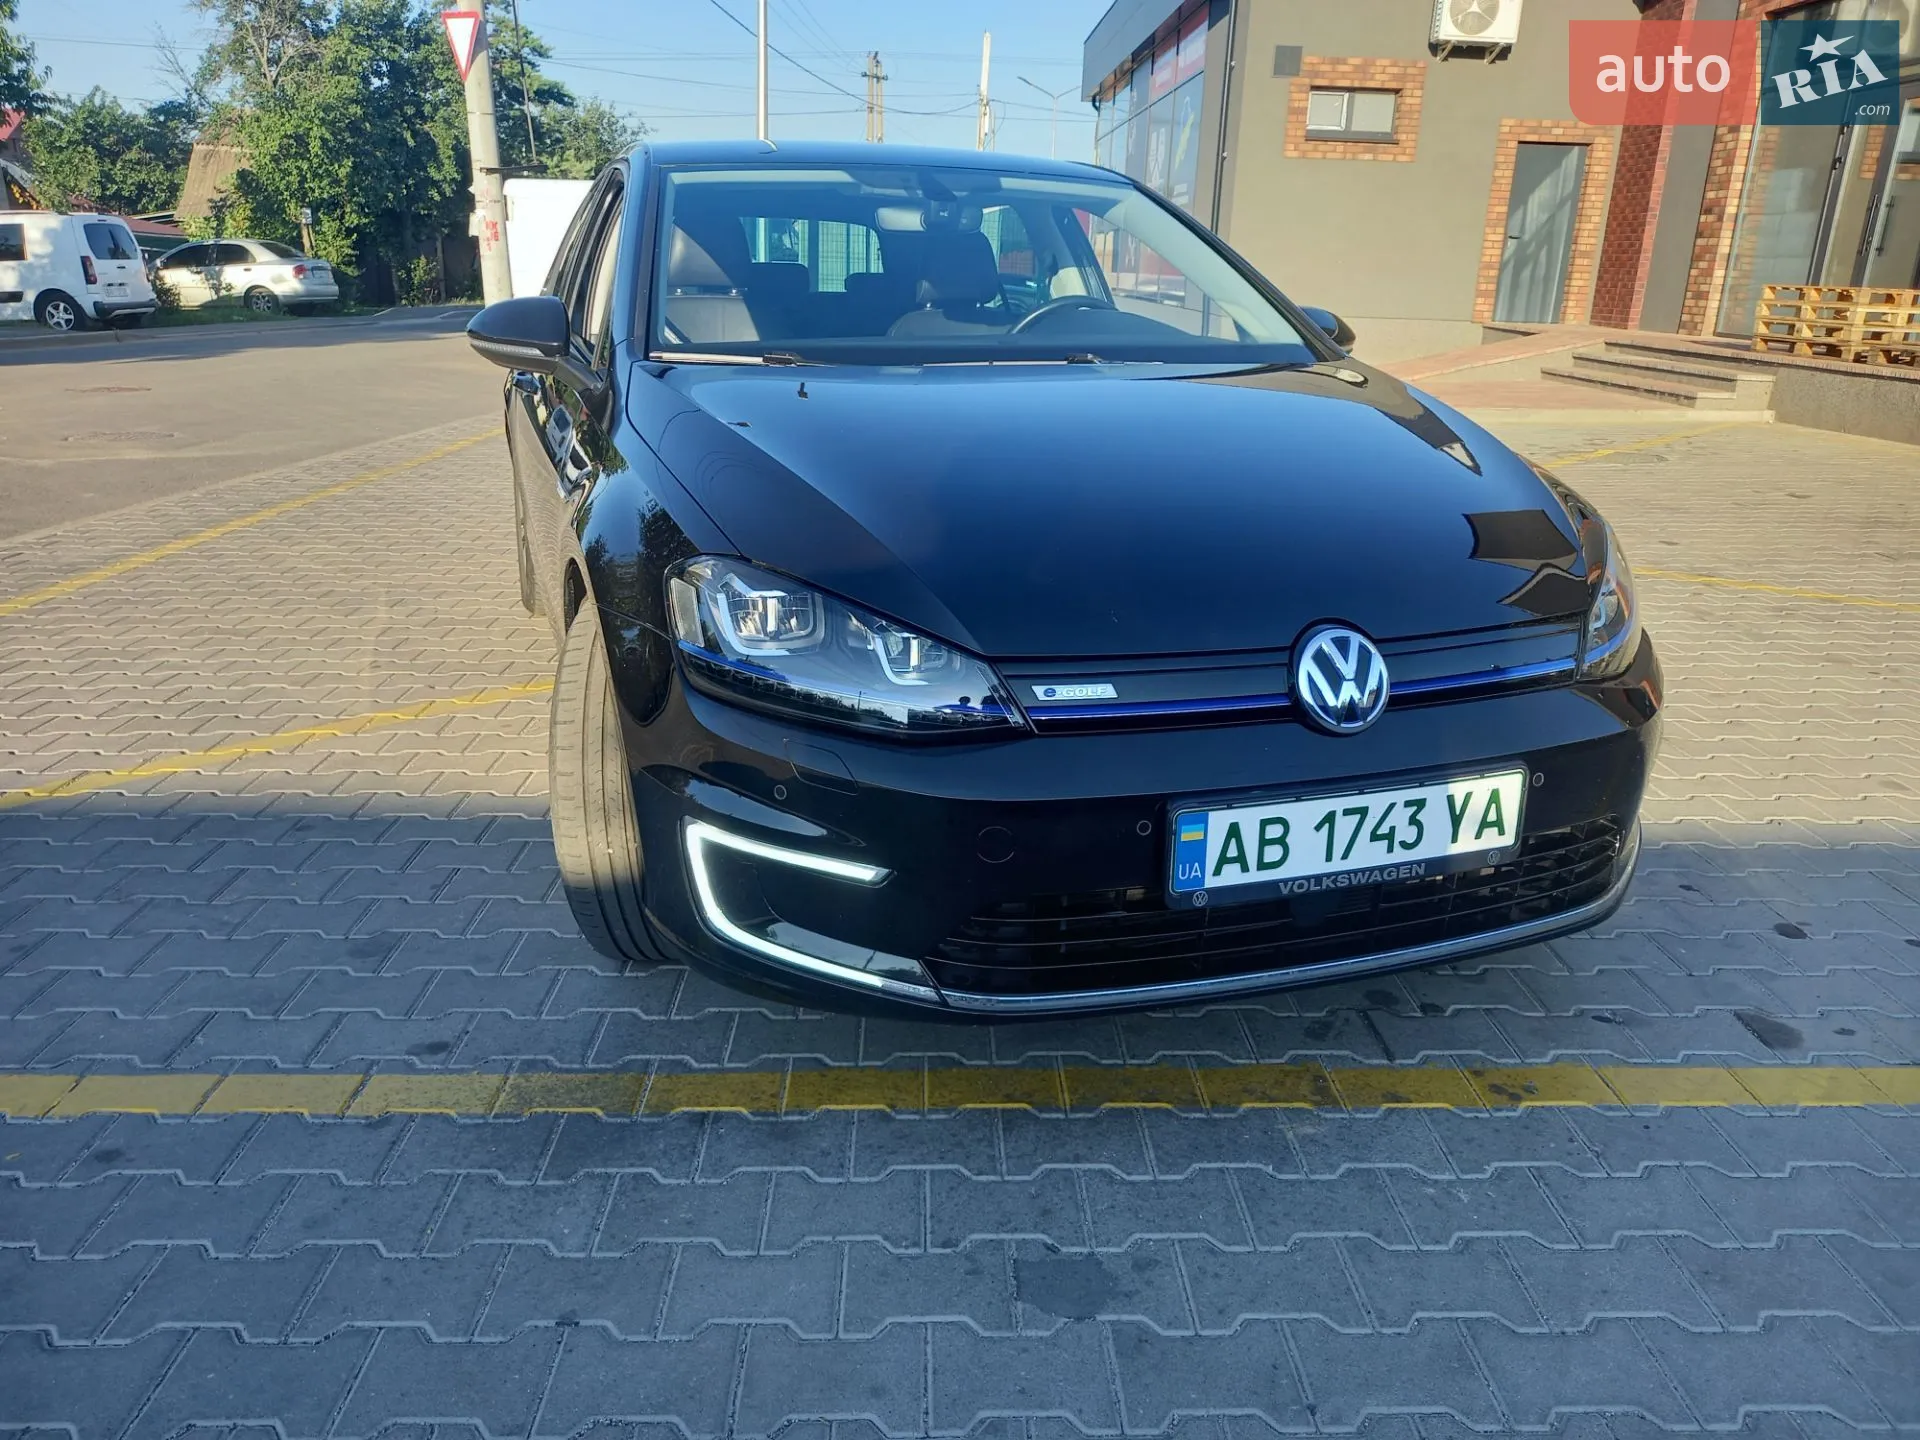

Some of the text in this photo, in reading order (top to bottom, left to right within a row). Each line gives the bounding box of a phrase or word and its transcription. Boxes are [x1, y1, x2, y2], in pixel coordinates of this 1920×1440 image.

[1212, 787, 1507, 877] AB 1743 YA
[1178, 863, 1202, 881] UA
[1278, 862, 1427, 895] VOLKSWAGEN
